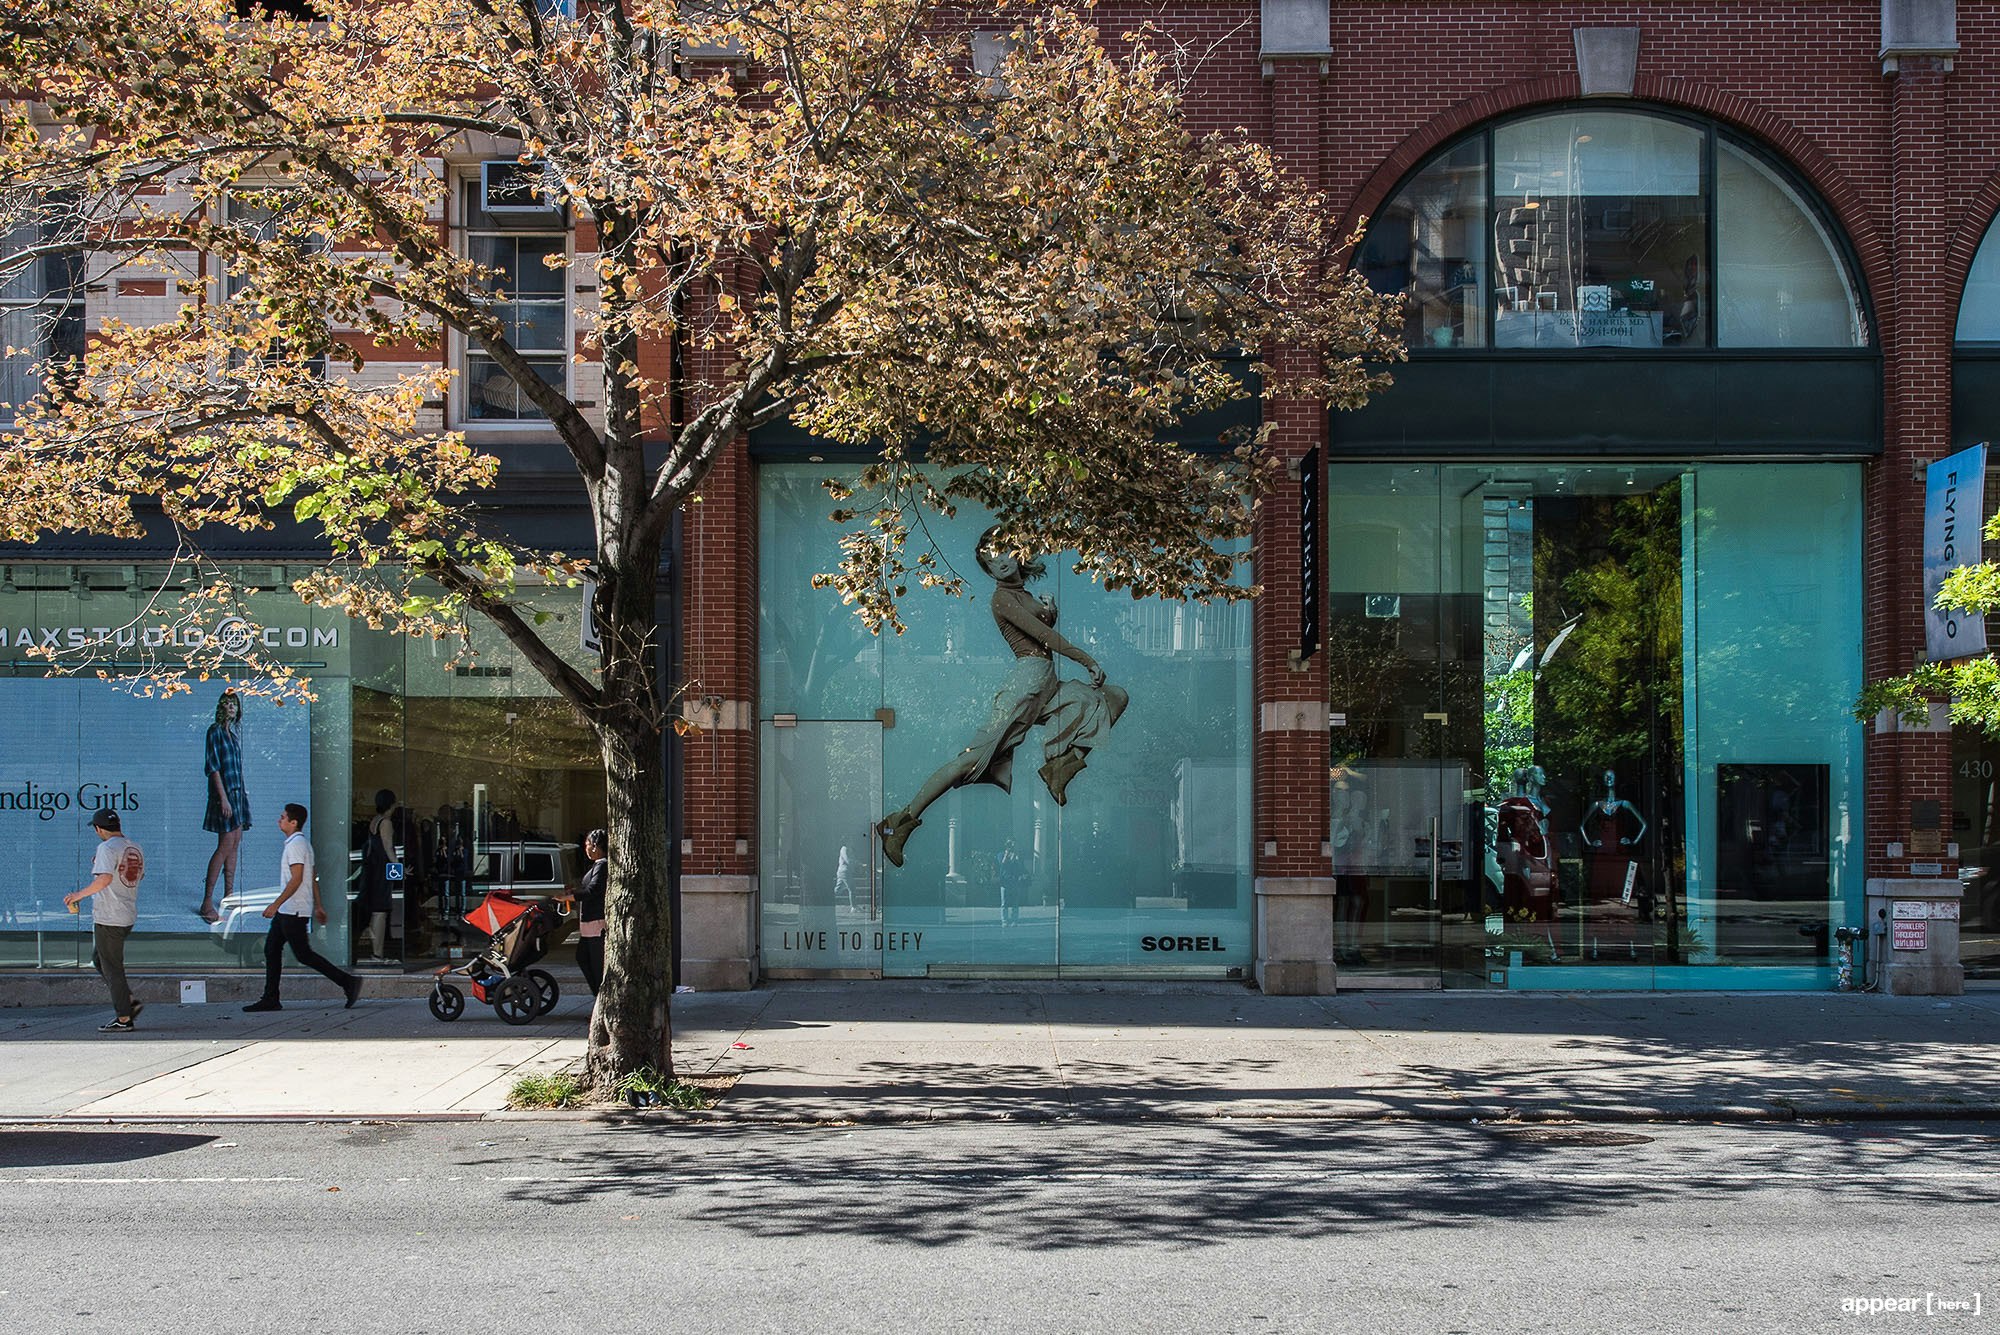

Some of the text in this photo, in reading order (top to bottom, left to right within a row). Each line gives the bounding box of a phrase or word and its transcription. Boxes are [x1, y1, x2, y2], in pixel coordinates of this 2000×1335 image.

[1629, 318, 1645, 326] MD
[1944, 471, 1957, 562] FLYING
[1959, 760, 1993, 778] 430
[77, 781, 139, 811] Girls
[1894, 922, 1925, 930] SPRINKLERS
[783, 931, 923, 951] LIVE TO DEFY
[1895, 931, 1925, 939] THROUGHOUT
[1141, 936, 1226, 951] SOREL
[1895, 939, 1925, 947] BUILDING
